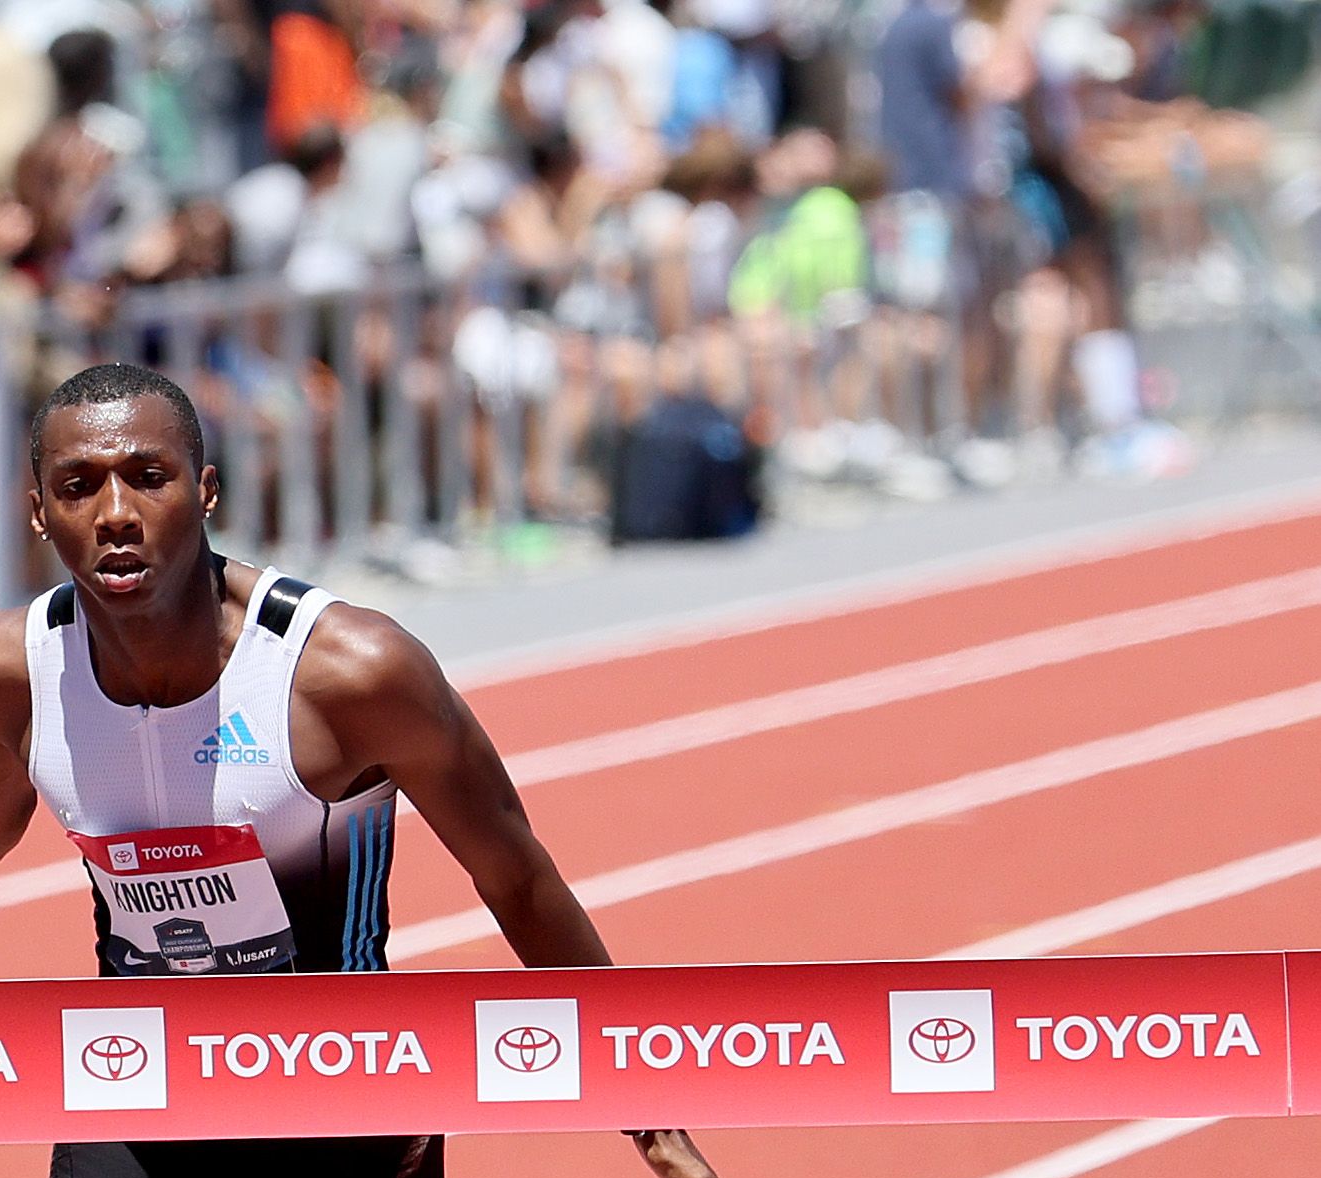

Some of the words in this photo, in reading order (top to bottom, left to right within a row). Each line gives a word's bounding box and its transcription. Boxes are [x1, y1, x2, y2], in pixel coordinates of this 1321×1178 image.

[194, 745, 269, 764] adidas
[141, 845, 203, 861] TOYOTA
[109, 872, 237, 914] KNIGHTON
[243, 946, 277, 963] USATF
[189, 1031, 431, 1078] TOYOTA
[602, 1023, 845, 1069] TOYOTA
[1016, 1014, 1261, 1061] TOYOTA
